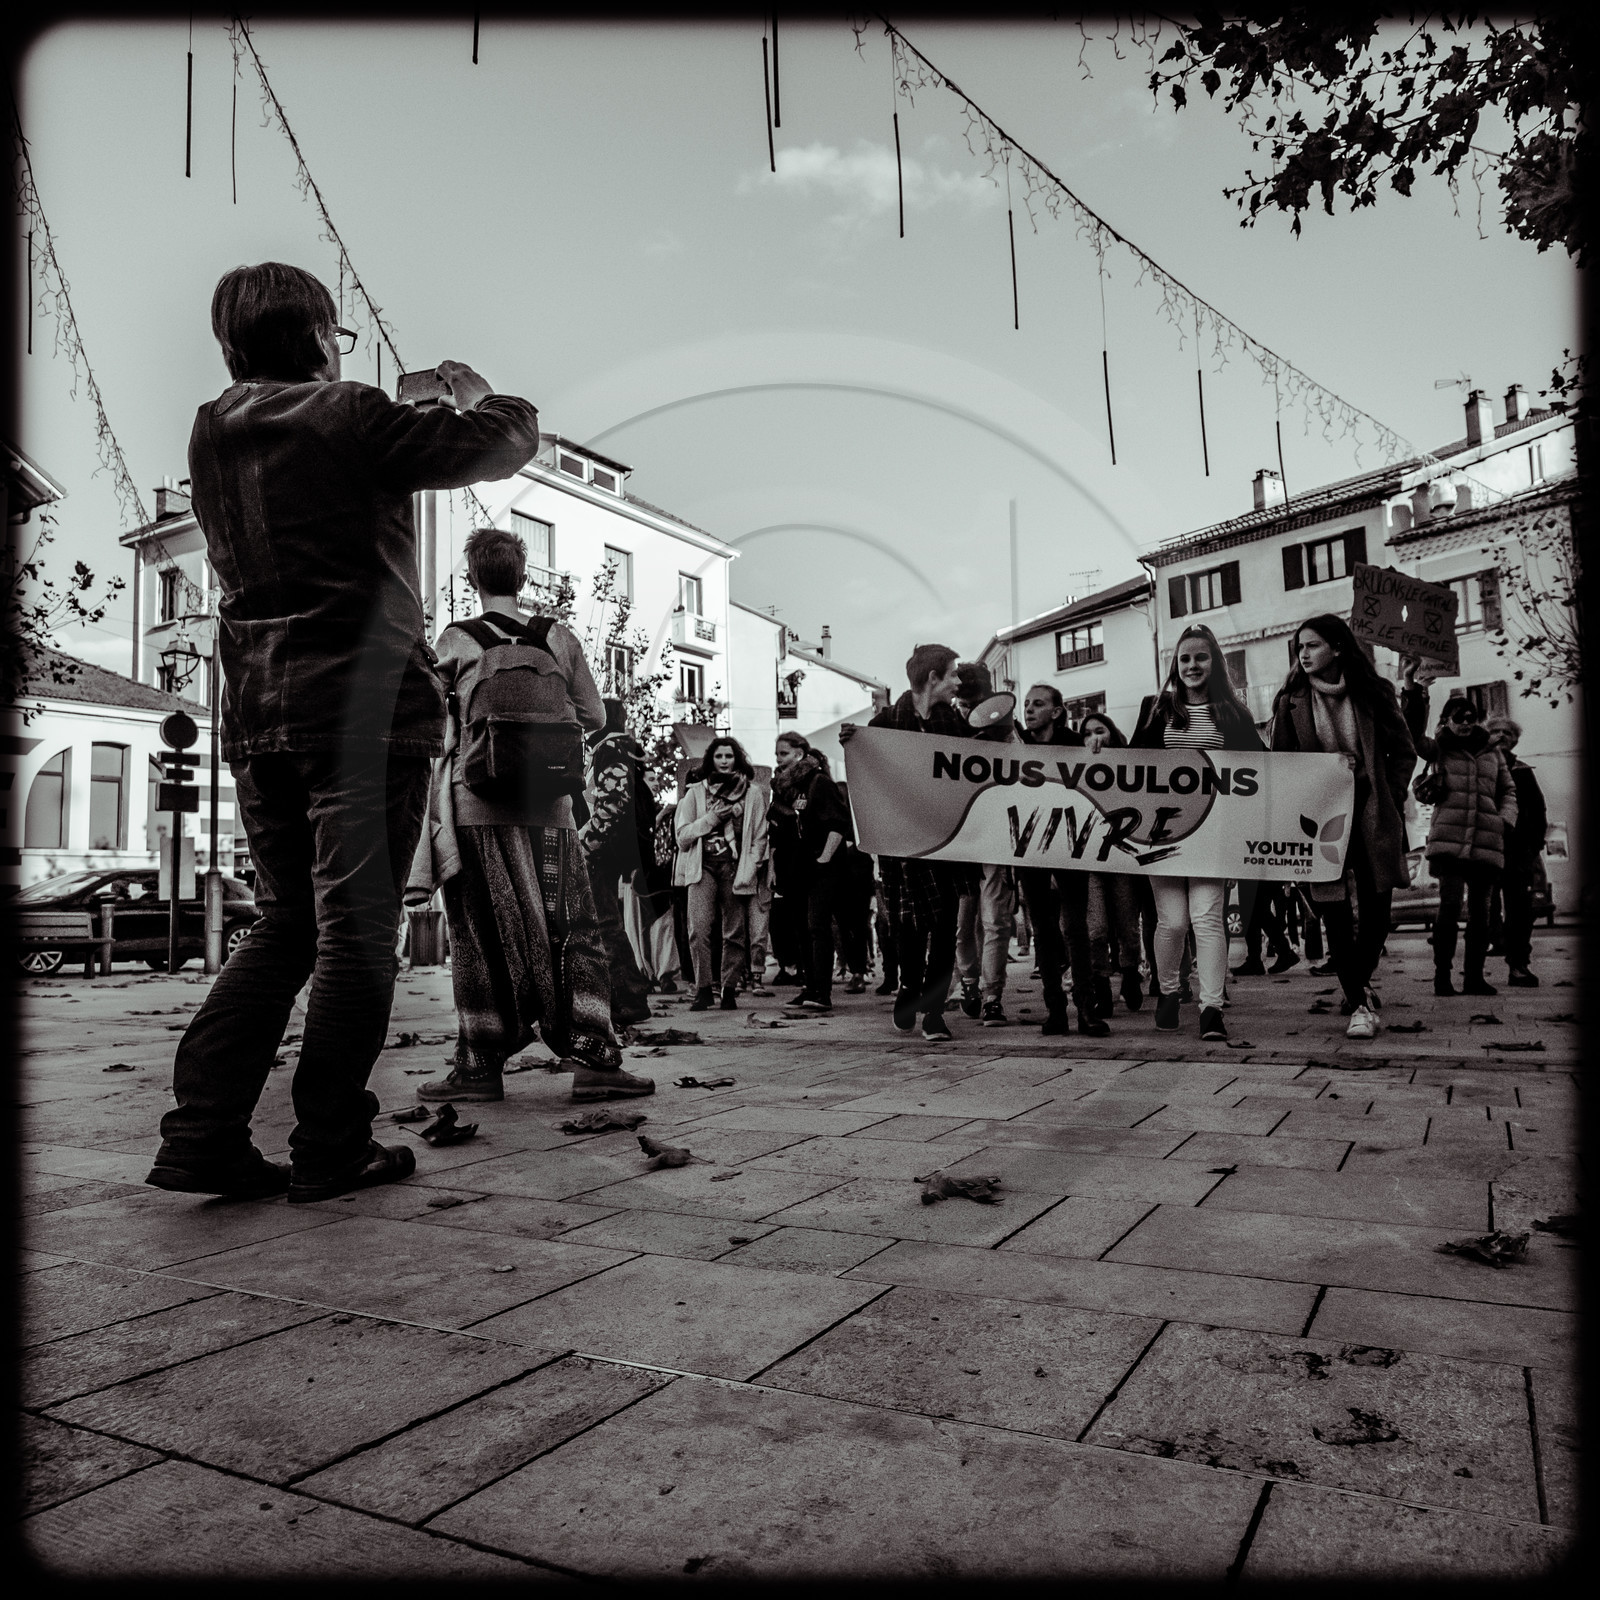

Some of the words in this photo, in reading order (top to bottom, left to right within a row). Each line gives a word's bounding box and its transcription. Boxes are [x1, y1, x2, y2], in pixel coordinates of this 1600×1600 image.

[1405, 585, 1420, 601] LE
[1352, 618, 1374, 634] PAS
[1378, 624, 1403, 639] LE
[932, 751, 1046, 788] NOUS
[1056, 762, 1259, 797] VOULONS
[1007, 805, 1184, 866] VIVRE
[1245, 841, 1313, 856] YOUTH
[1243, 857, 1265, 865] FOR
[1267, 858, 1313, 867] CLIMATE
